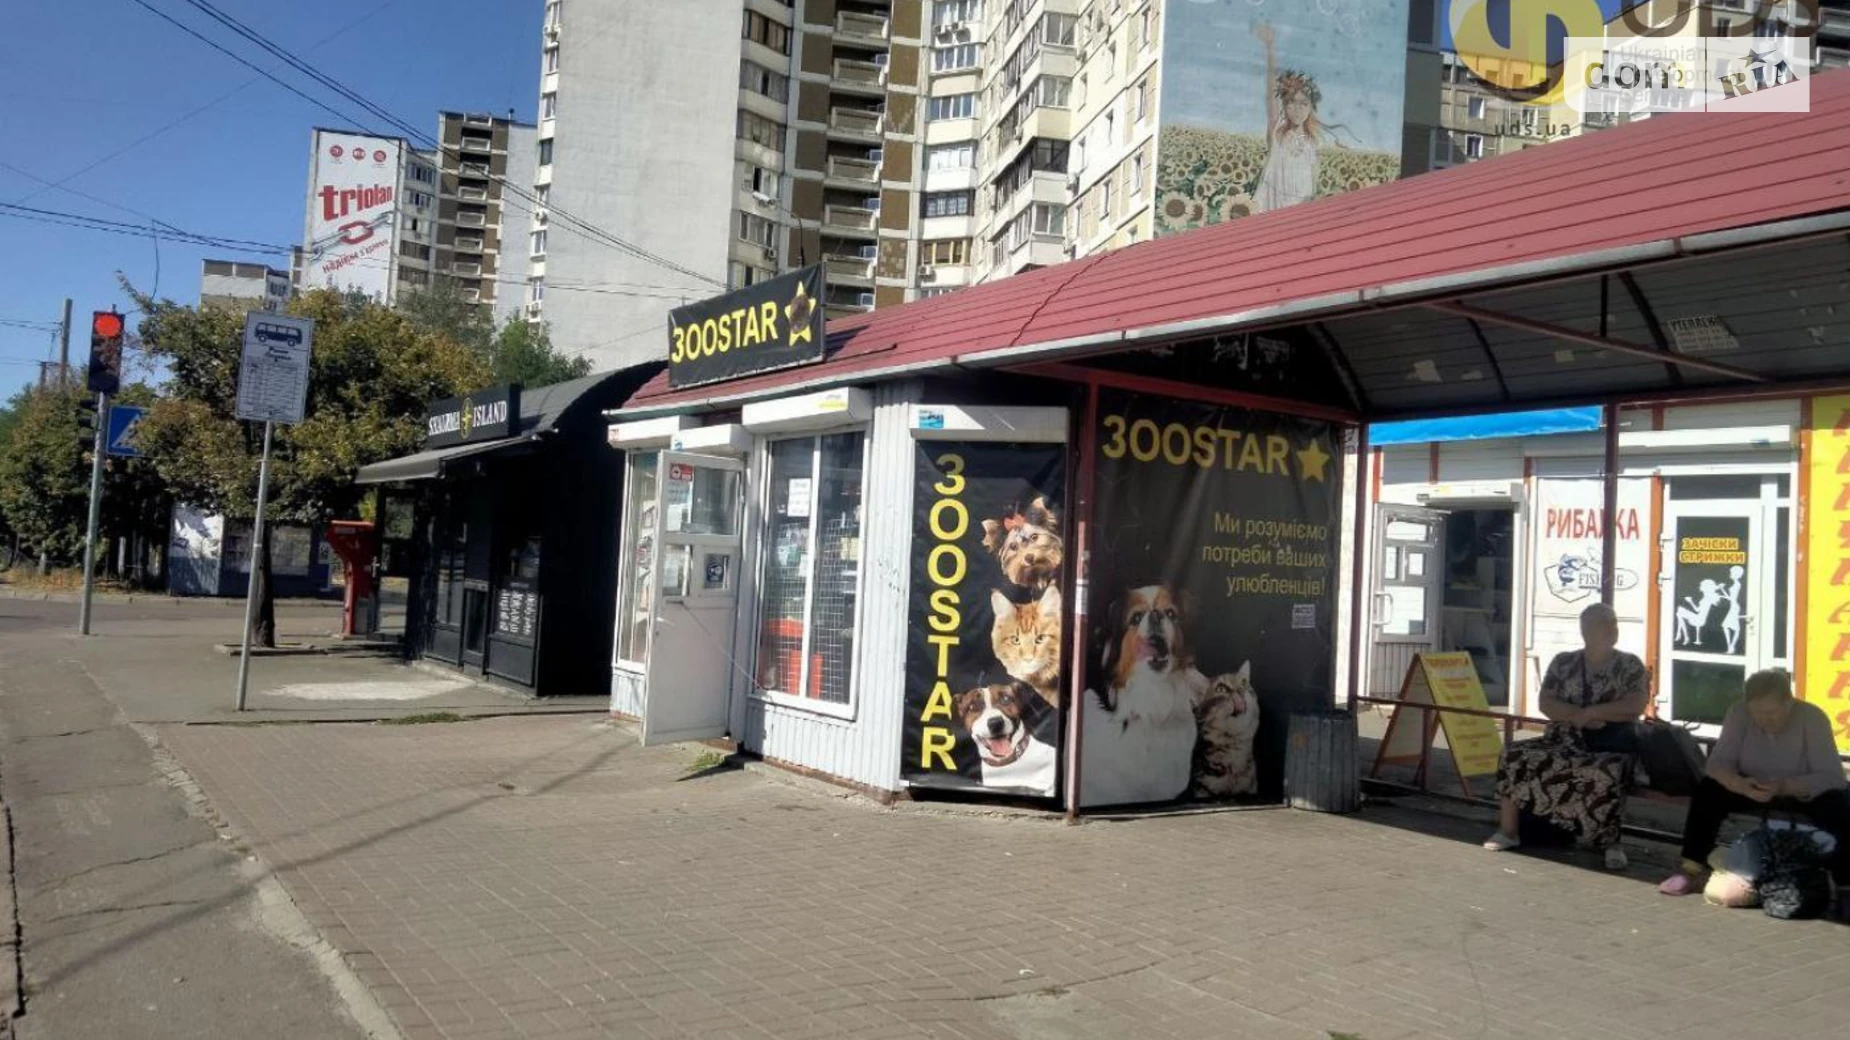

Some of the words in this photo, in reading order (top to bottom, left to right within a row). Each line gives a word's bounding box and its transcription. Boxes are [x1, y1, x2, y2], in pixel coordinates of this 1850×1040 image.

[317, 184, 393, 221] triolan
[472, 400, 507, 427] ISLAND
[1214, 511, 1240, 533] Ми
[1245, 518, 1328, 542] розуміємо
[1203, 544, 1271, 567] потреби
[1276, 547, 1326, 567] ваших
[1680, 551, 1744, 562] СТРИЖКИ
[1226, 573, 1325, 598] улюбленців!
[1578, 571, 1624, 586] FISG
